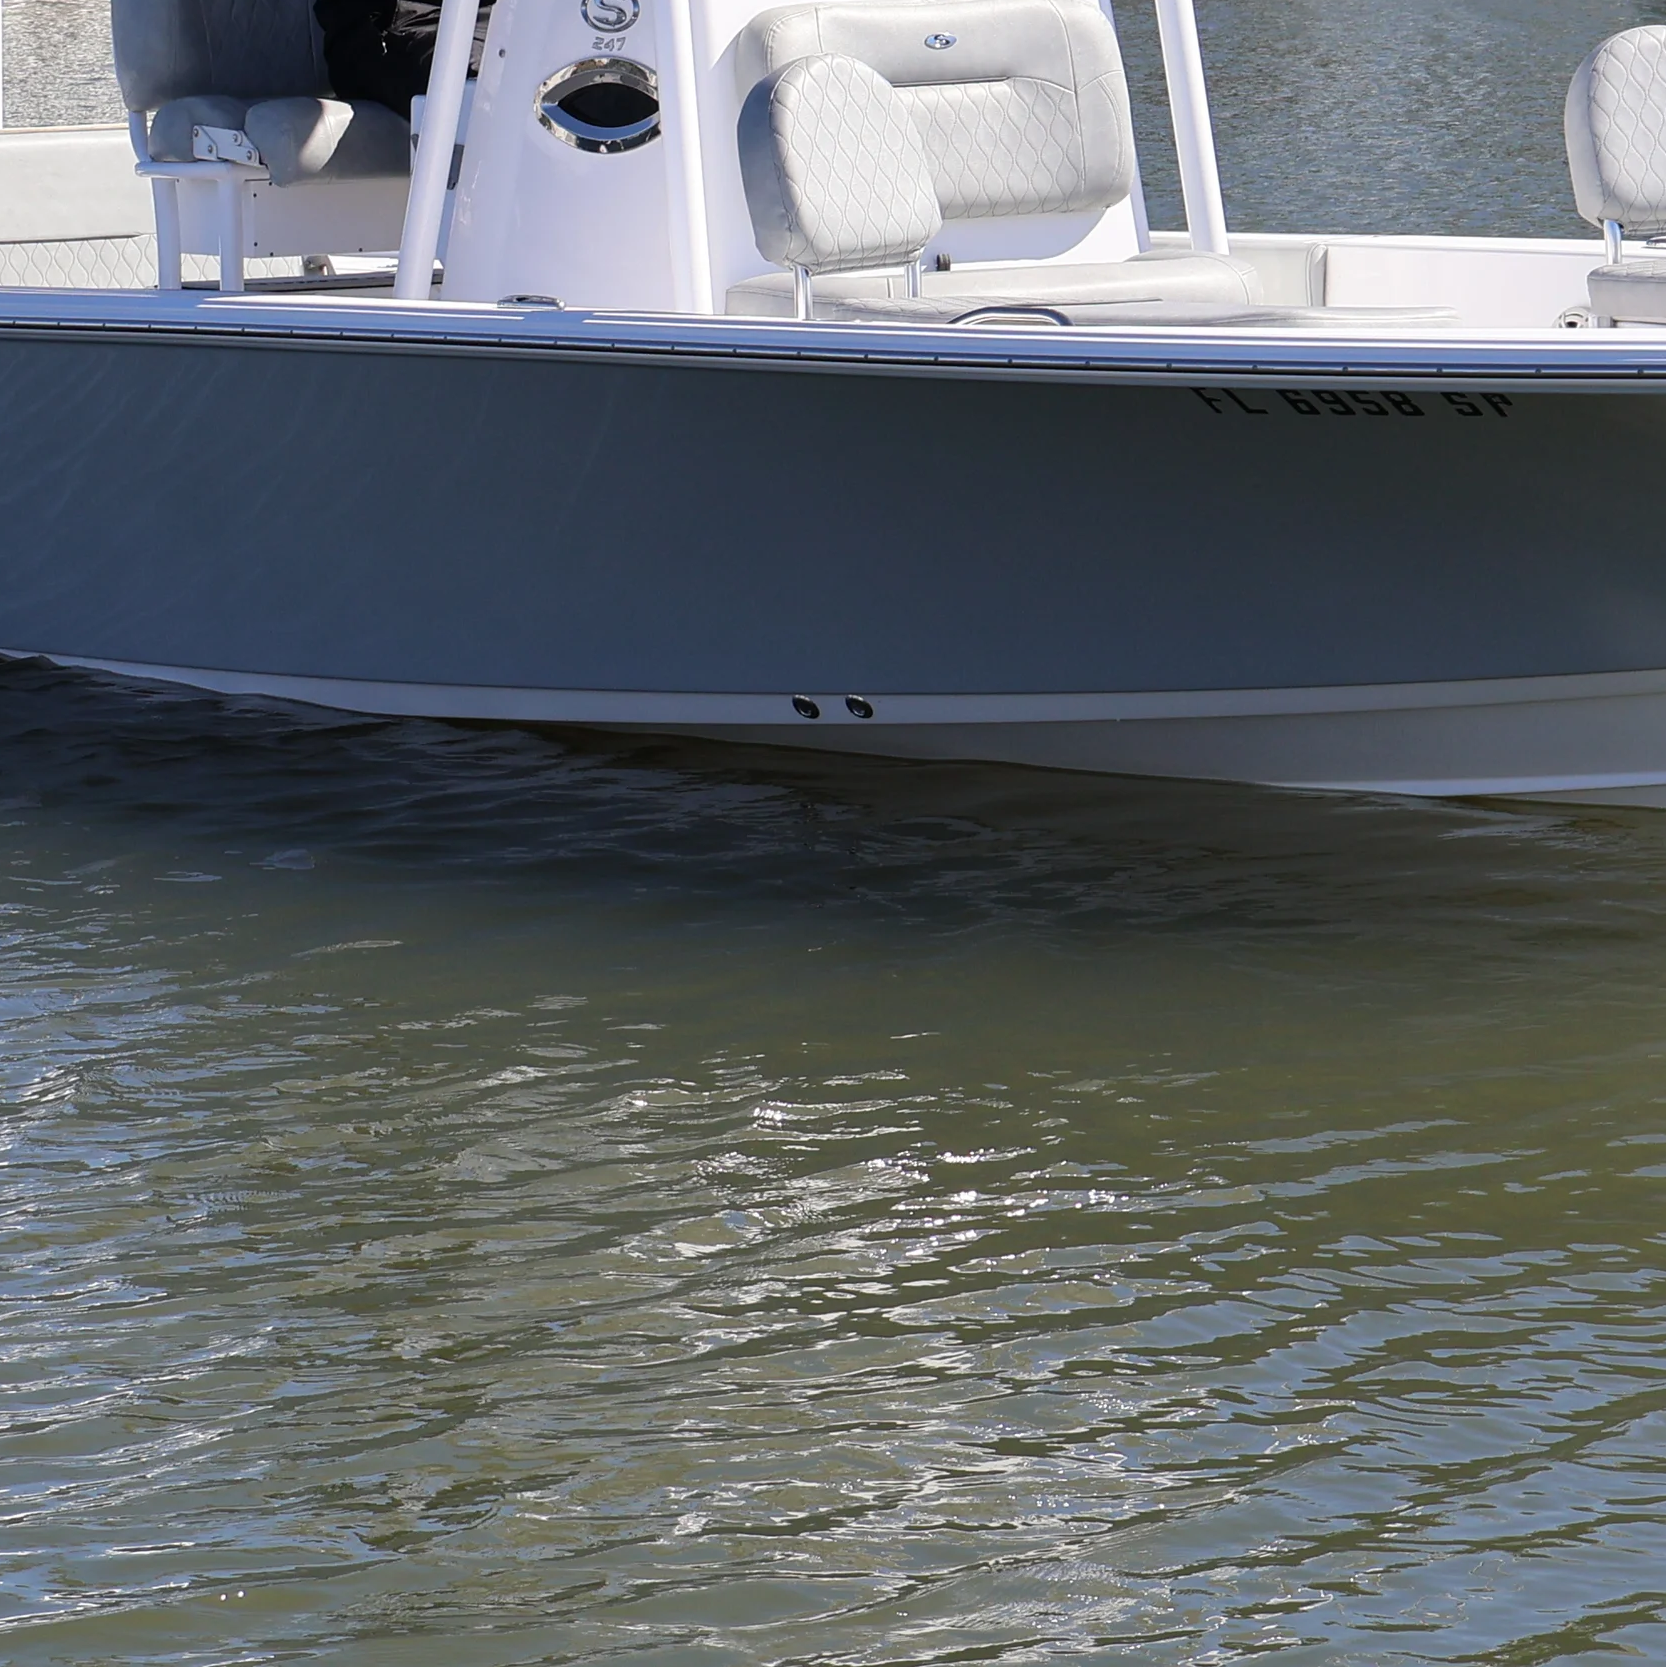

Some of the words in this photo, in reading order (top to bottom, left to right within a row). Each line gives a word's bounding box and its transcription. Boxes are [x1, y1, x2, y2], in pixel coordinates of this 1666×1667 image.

[592, 36, 626, 51] 247
[1190, 387, 1269, 414] FL
[1275, 389, 1425, 416] 6958
